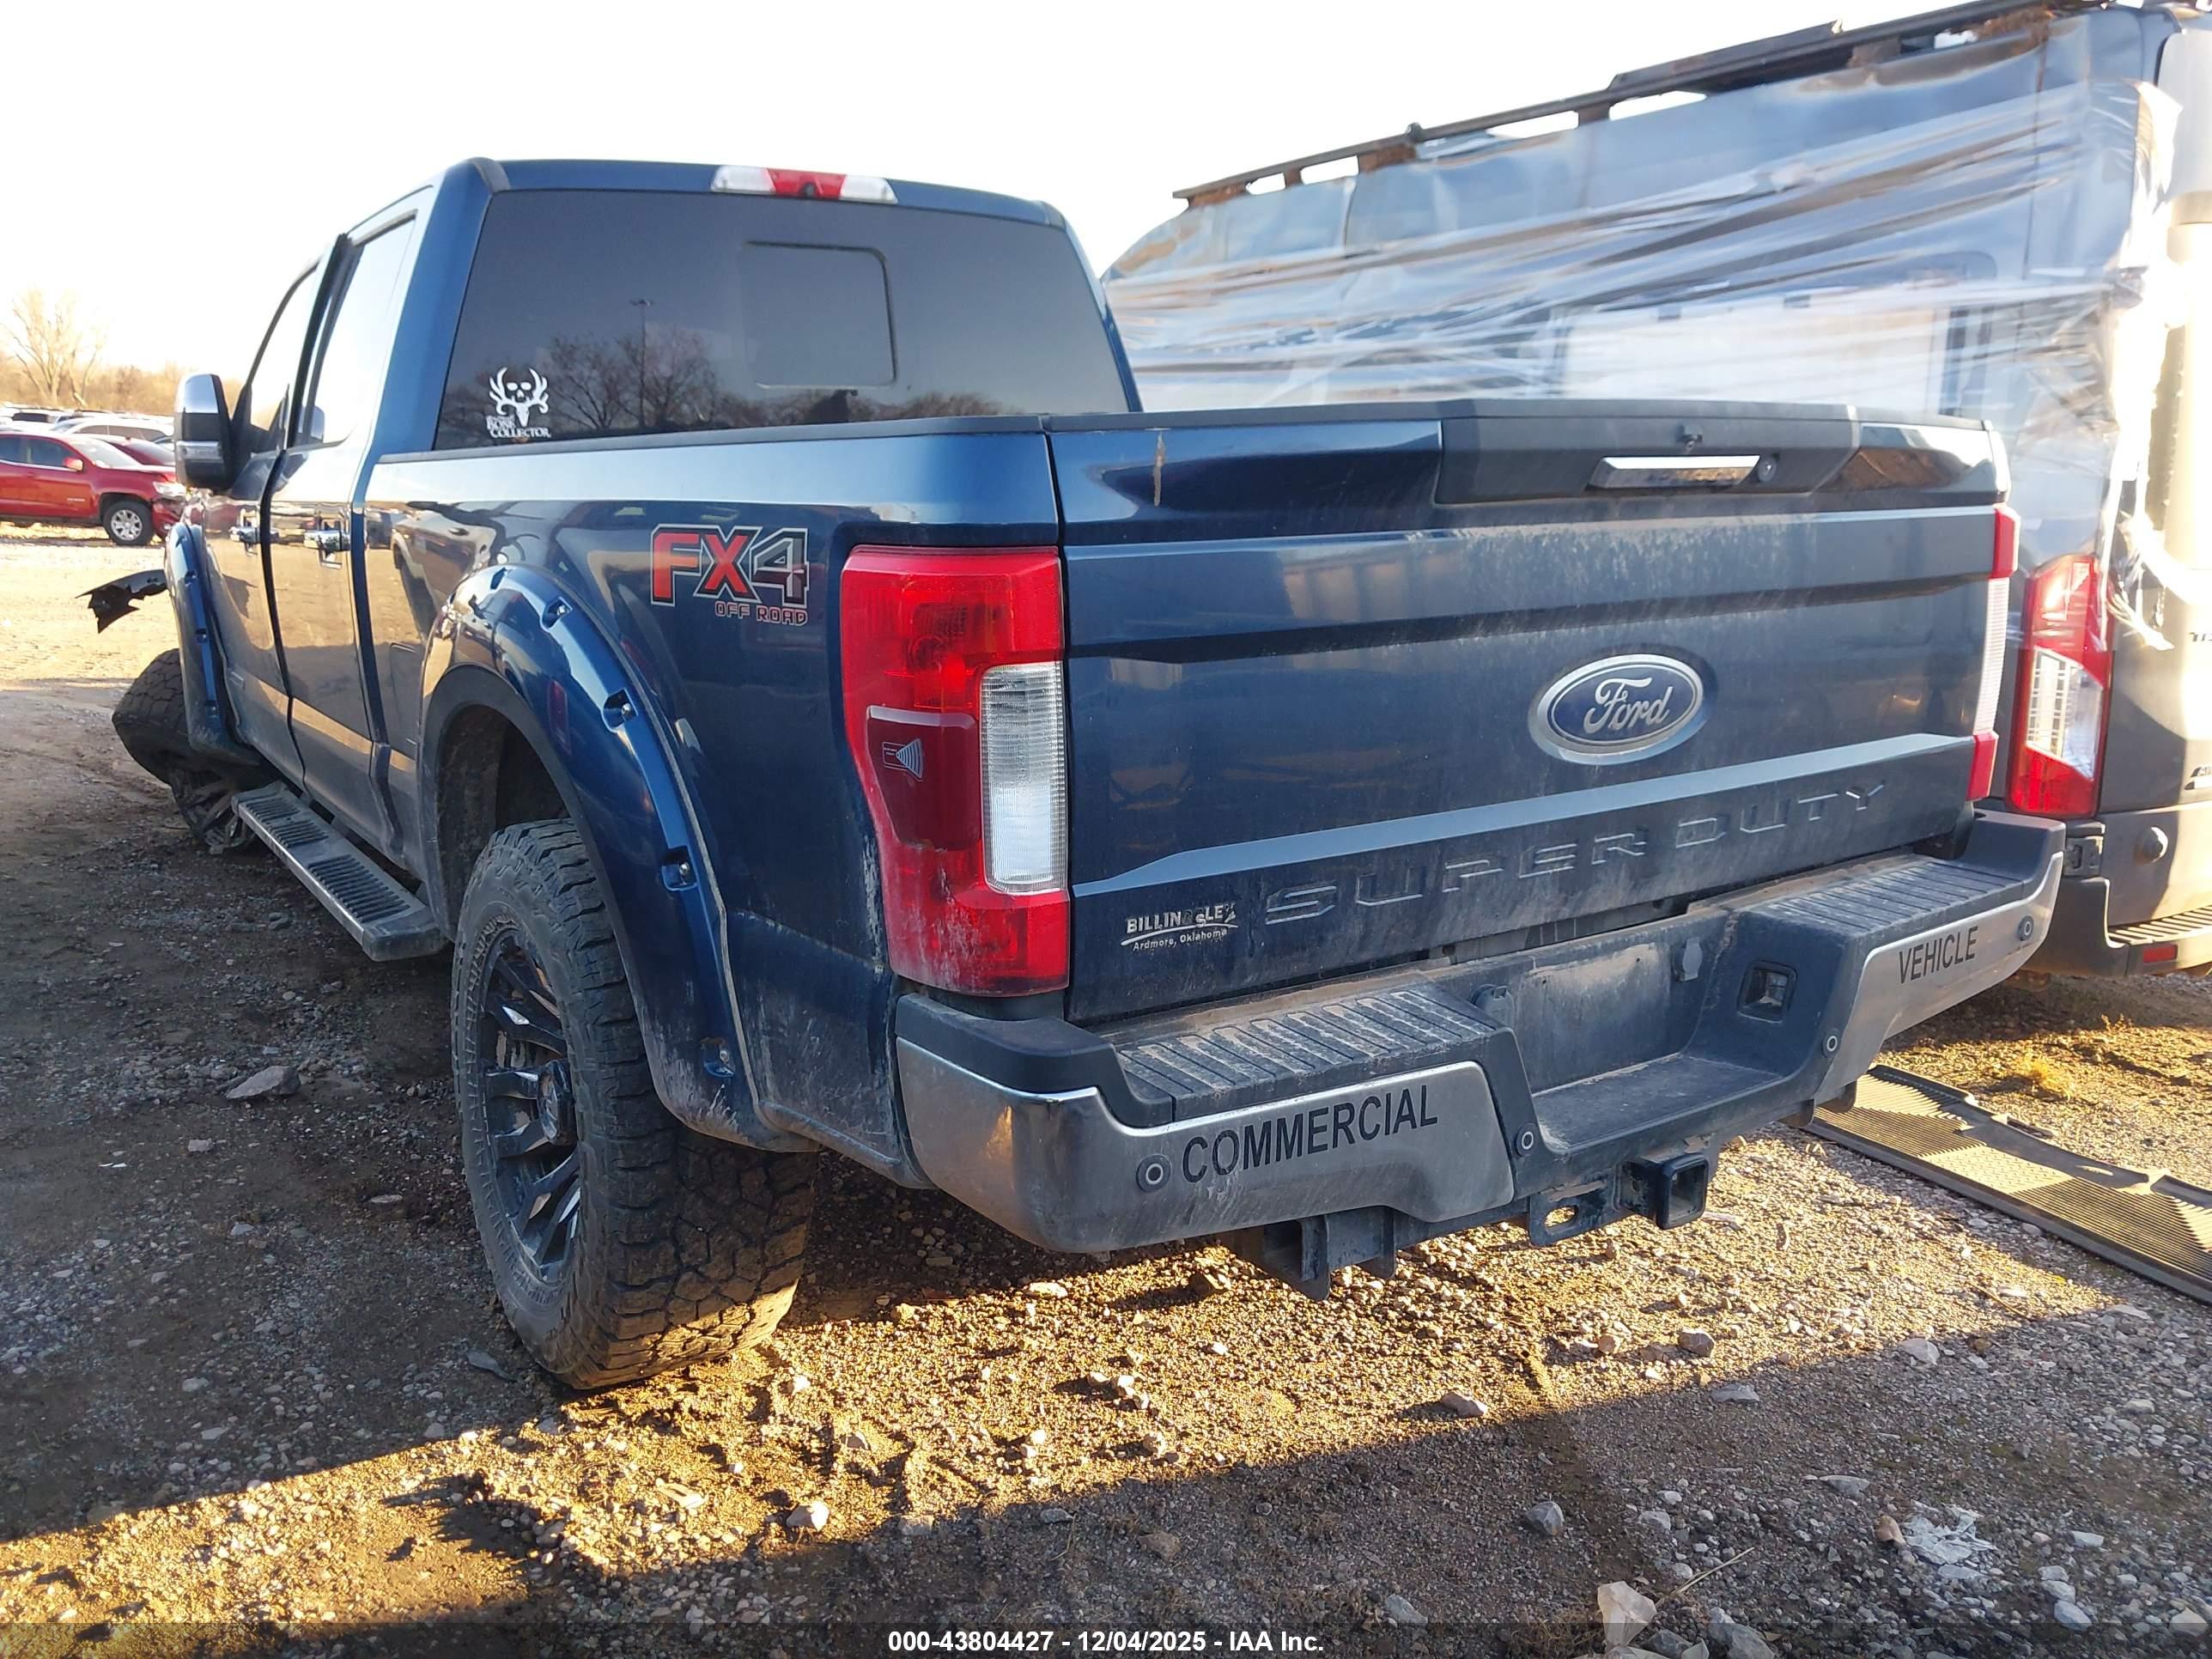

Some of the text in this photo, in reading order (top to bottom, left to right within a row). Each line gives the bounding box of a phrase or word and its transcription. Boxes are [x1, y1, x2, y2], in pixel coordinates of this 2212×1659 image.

[489, 428, 551, 438] COLLECTOR
[651, 524, 810, 608] FX4
[714, 600, 808, 626] OFF ROAD
[1583, 677, 1674, 734] Ford
[1265, 780, 1886, 926] SUPER DUTY
[1133, 928, 1227, 951] Ardmore, Oklahoma
[1899, 926, 1978, 984] VEHICLE
[1182, 1085, 1438, 1183] COMMERCIAL
